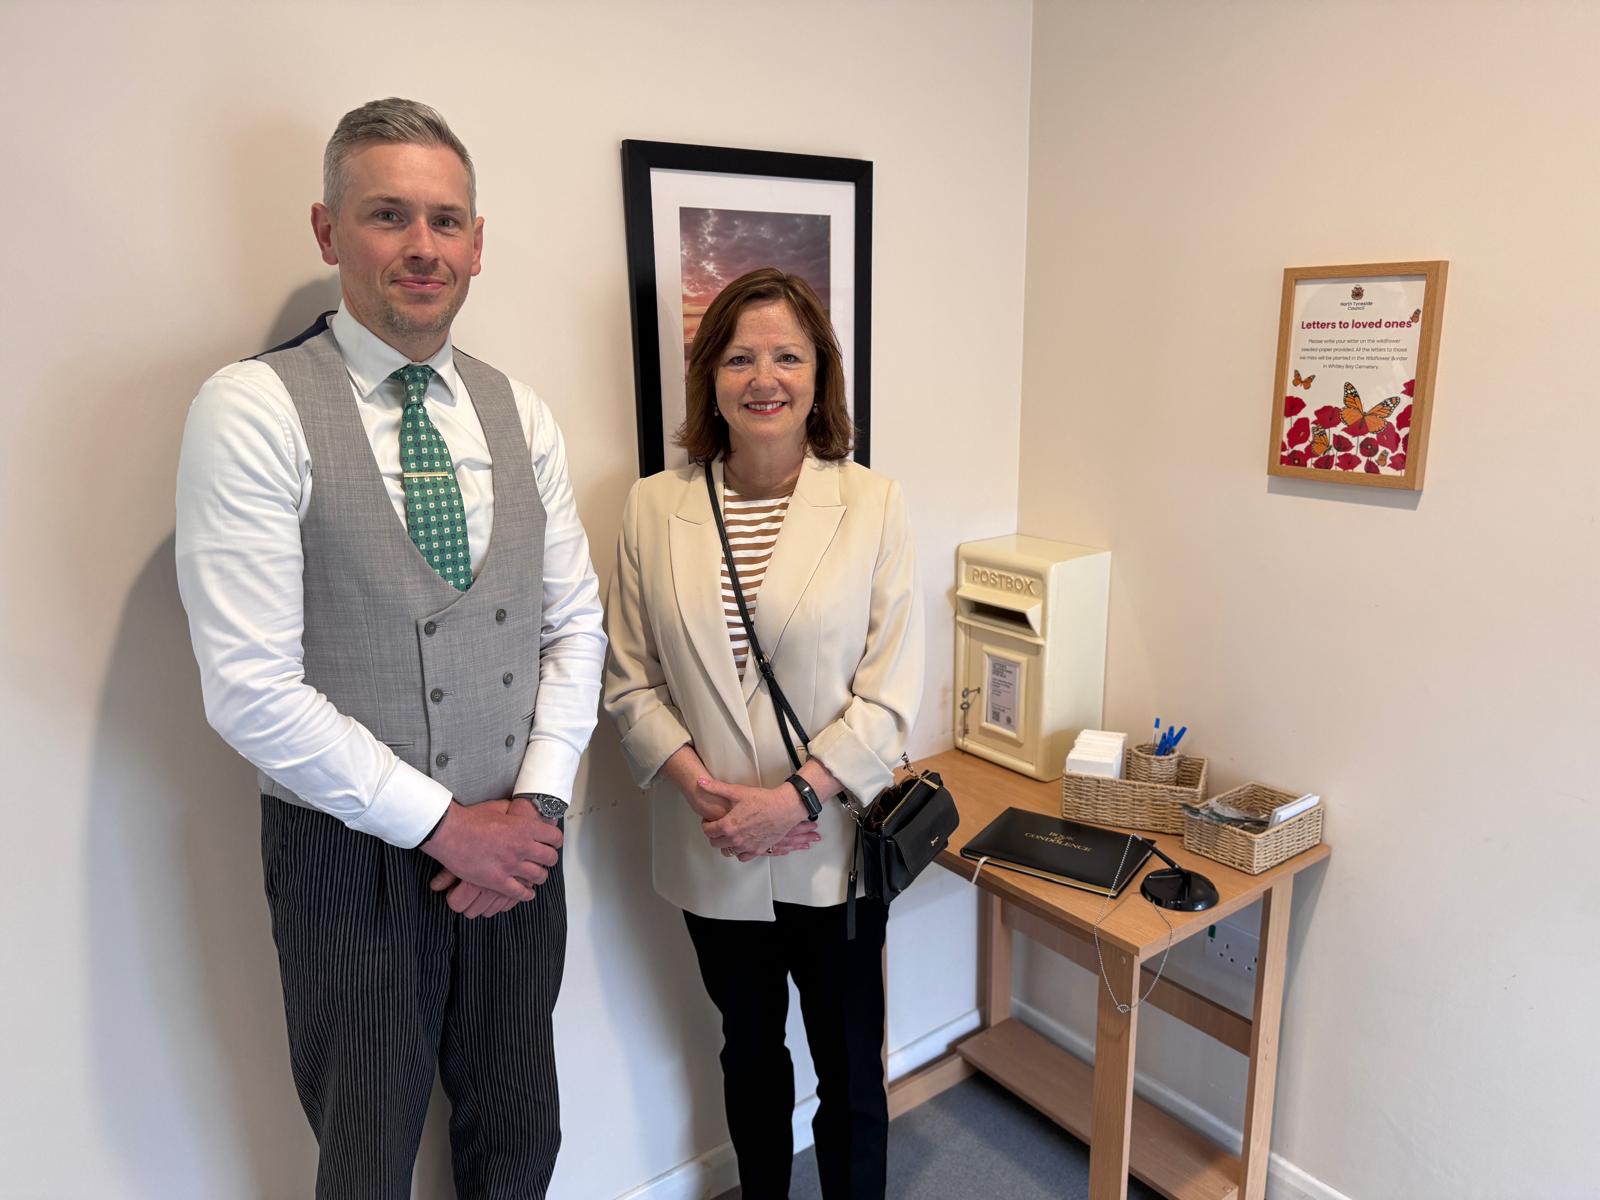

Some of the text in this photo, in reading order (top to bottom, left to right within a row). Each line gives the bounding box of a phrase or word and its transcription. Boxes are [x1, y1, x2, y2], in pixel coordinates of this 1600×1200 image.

[1301, 318, 1412, 330] Letters to loved ones
[972, 568, 1035, 594] POSTBOX
